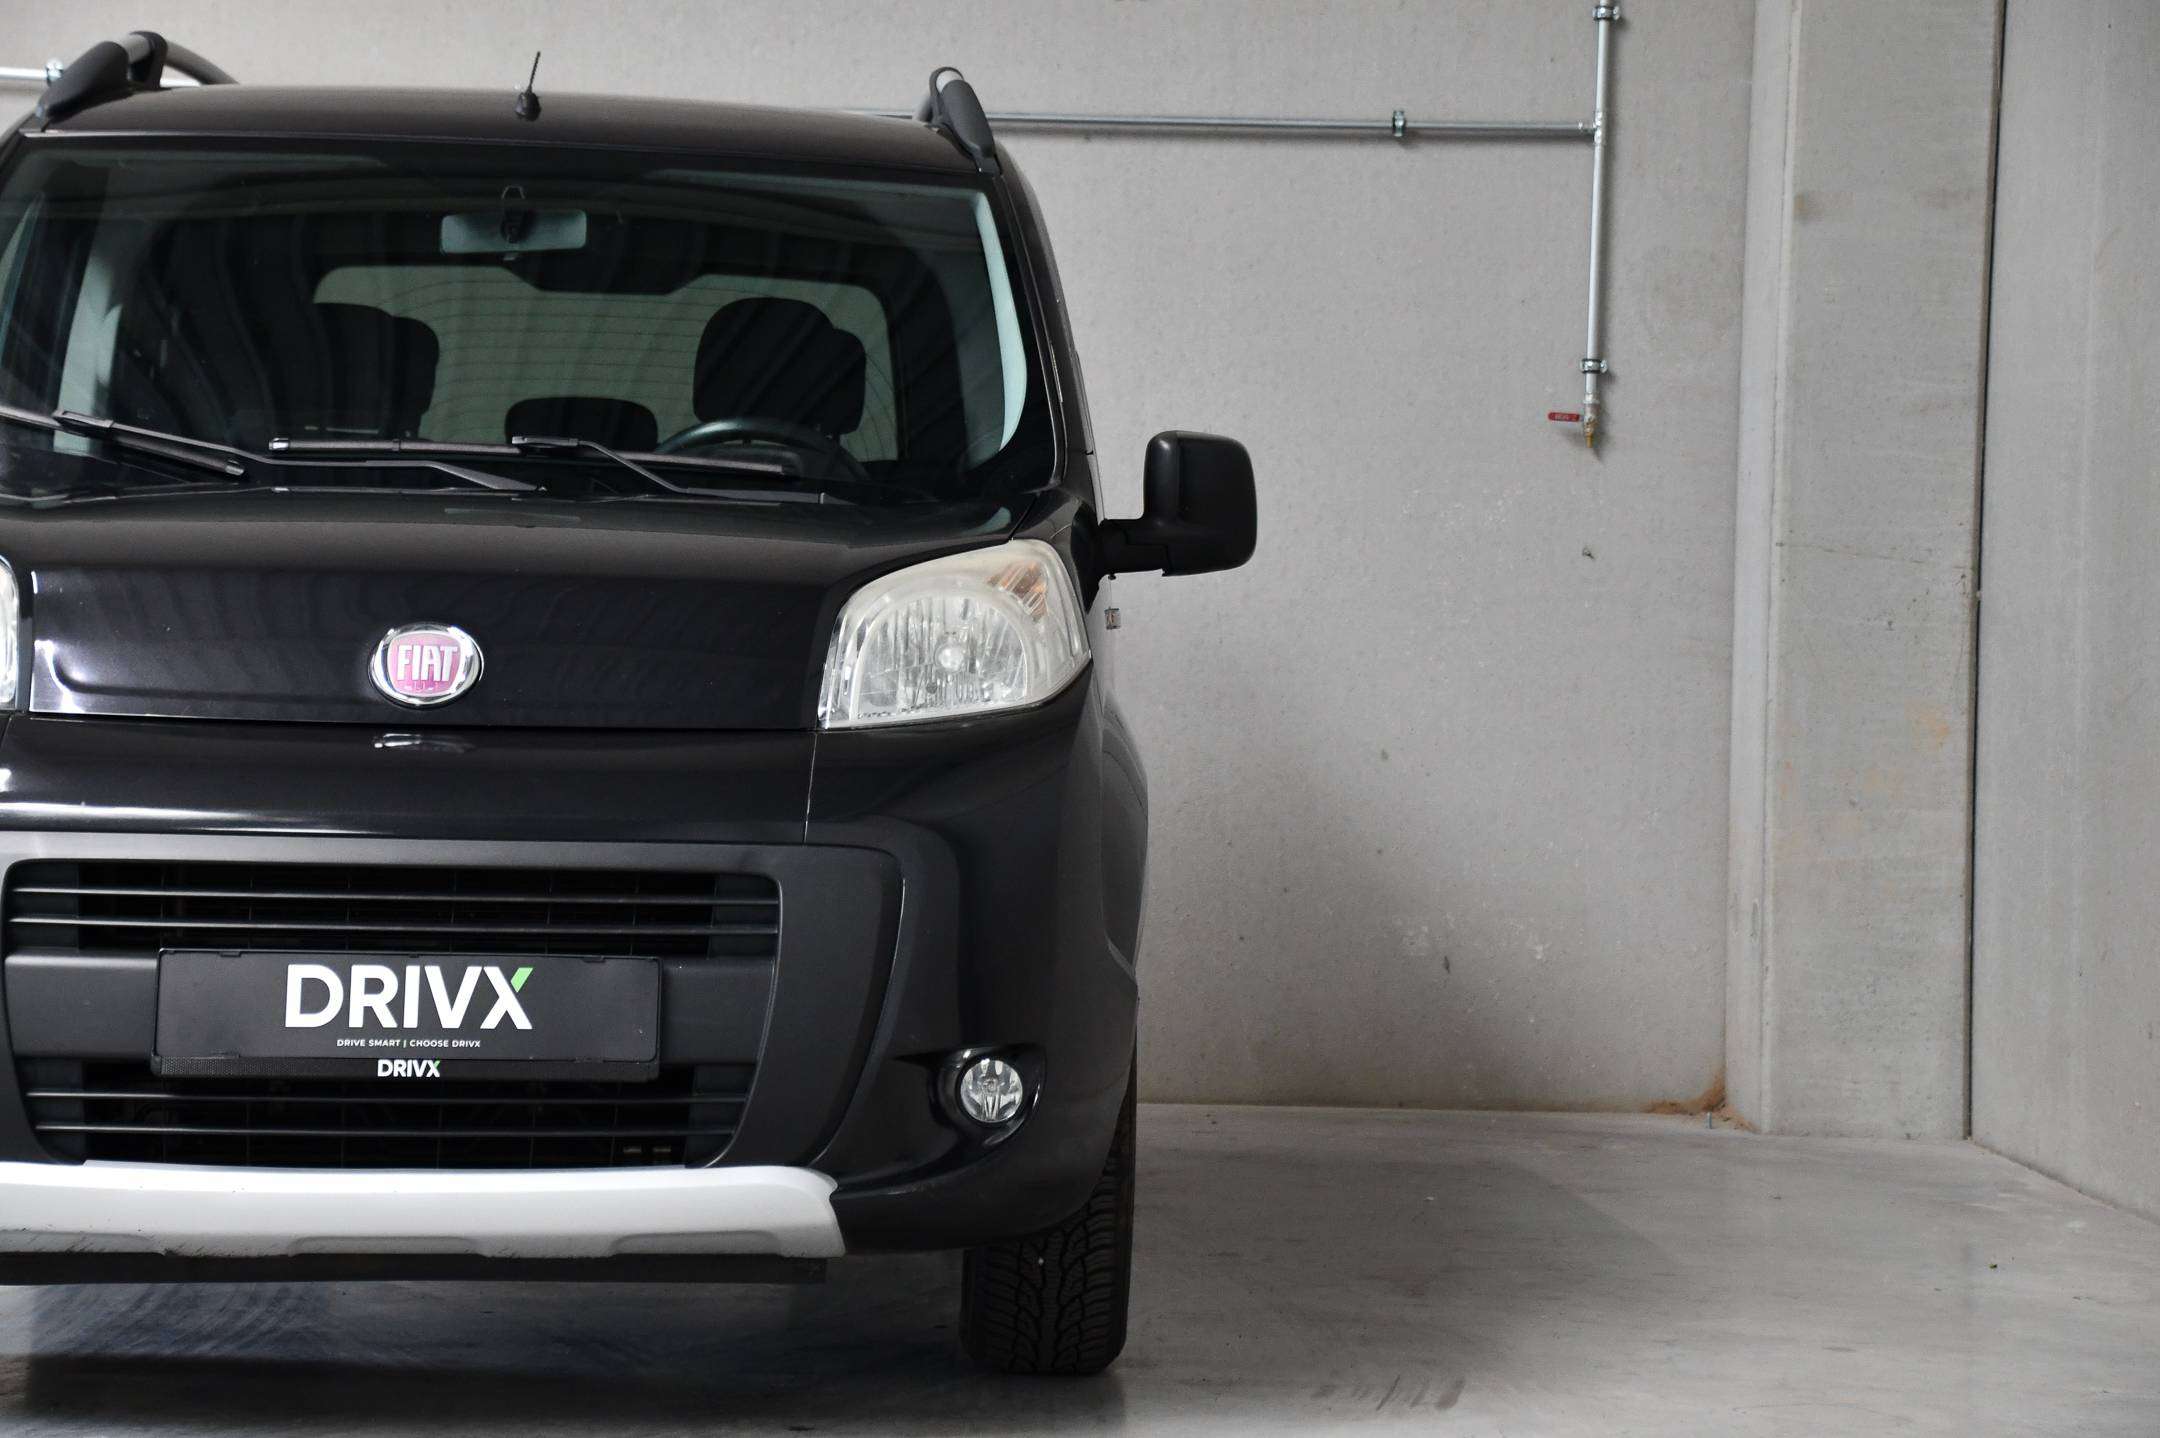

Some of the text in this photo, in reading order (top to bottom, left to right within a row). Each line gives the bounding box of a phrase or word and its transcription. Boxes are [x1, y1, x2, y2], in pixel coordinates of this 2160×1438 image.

[397, 644, 458, 682] FIAT
[284, 963, 534, 1030] DRIVX
[336, 1038, 366, 1047] DRIVE
[368, 1039, 401, 1048] SMART
[409, 1039, 449, 1048] CHOOSE
[451, 1040, 481, 1048] DRIVX
[377, 1058, 441, 1078] DRIVX
